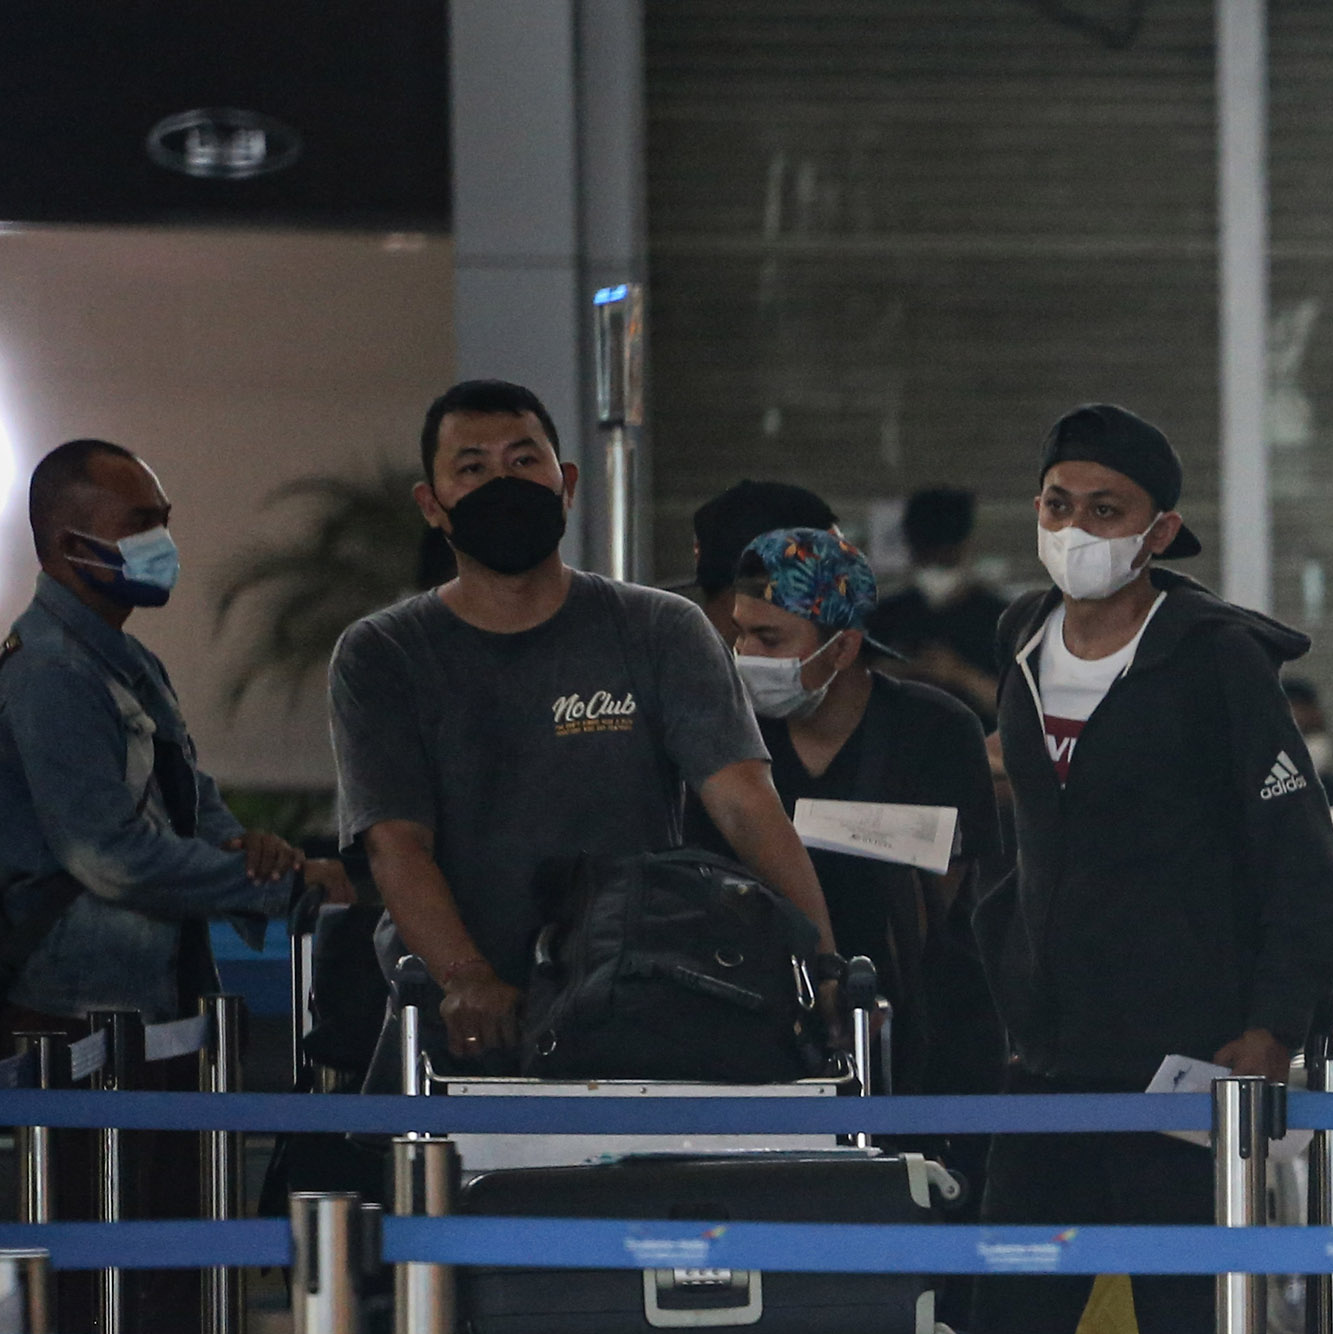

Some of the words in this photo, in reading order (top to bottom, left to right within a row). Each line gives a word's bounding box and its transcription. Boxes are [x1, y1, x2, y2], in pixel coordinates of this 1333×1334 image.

[552, 693, 585, 722] No
[586, 690, 637, 719] Club
[1260, 774, 1307, 800] adidas
